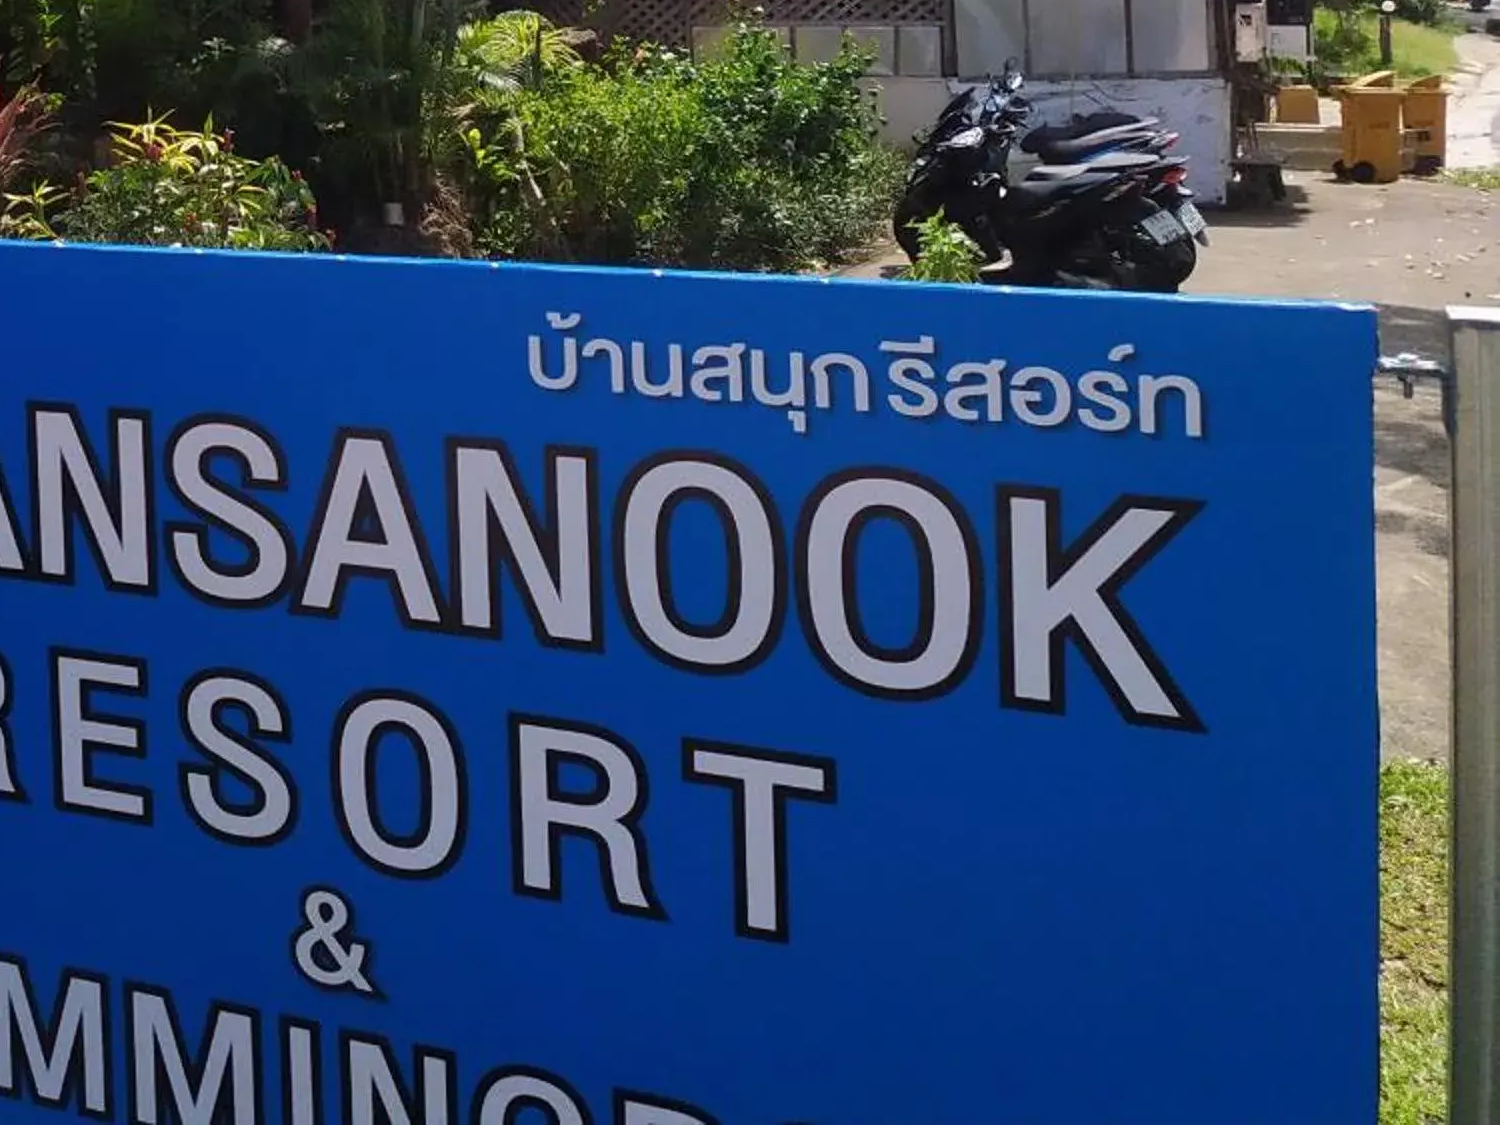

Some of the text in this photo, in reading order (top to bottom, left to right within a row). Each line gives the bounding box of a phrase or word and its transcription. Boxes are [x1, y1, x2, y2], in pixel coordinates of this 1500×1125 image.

[526, 311, 1203, 438] บ้านสนุก รีสอร์ท
[295, 889, 374, 993] &
